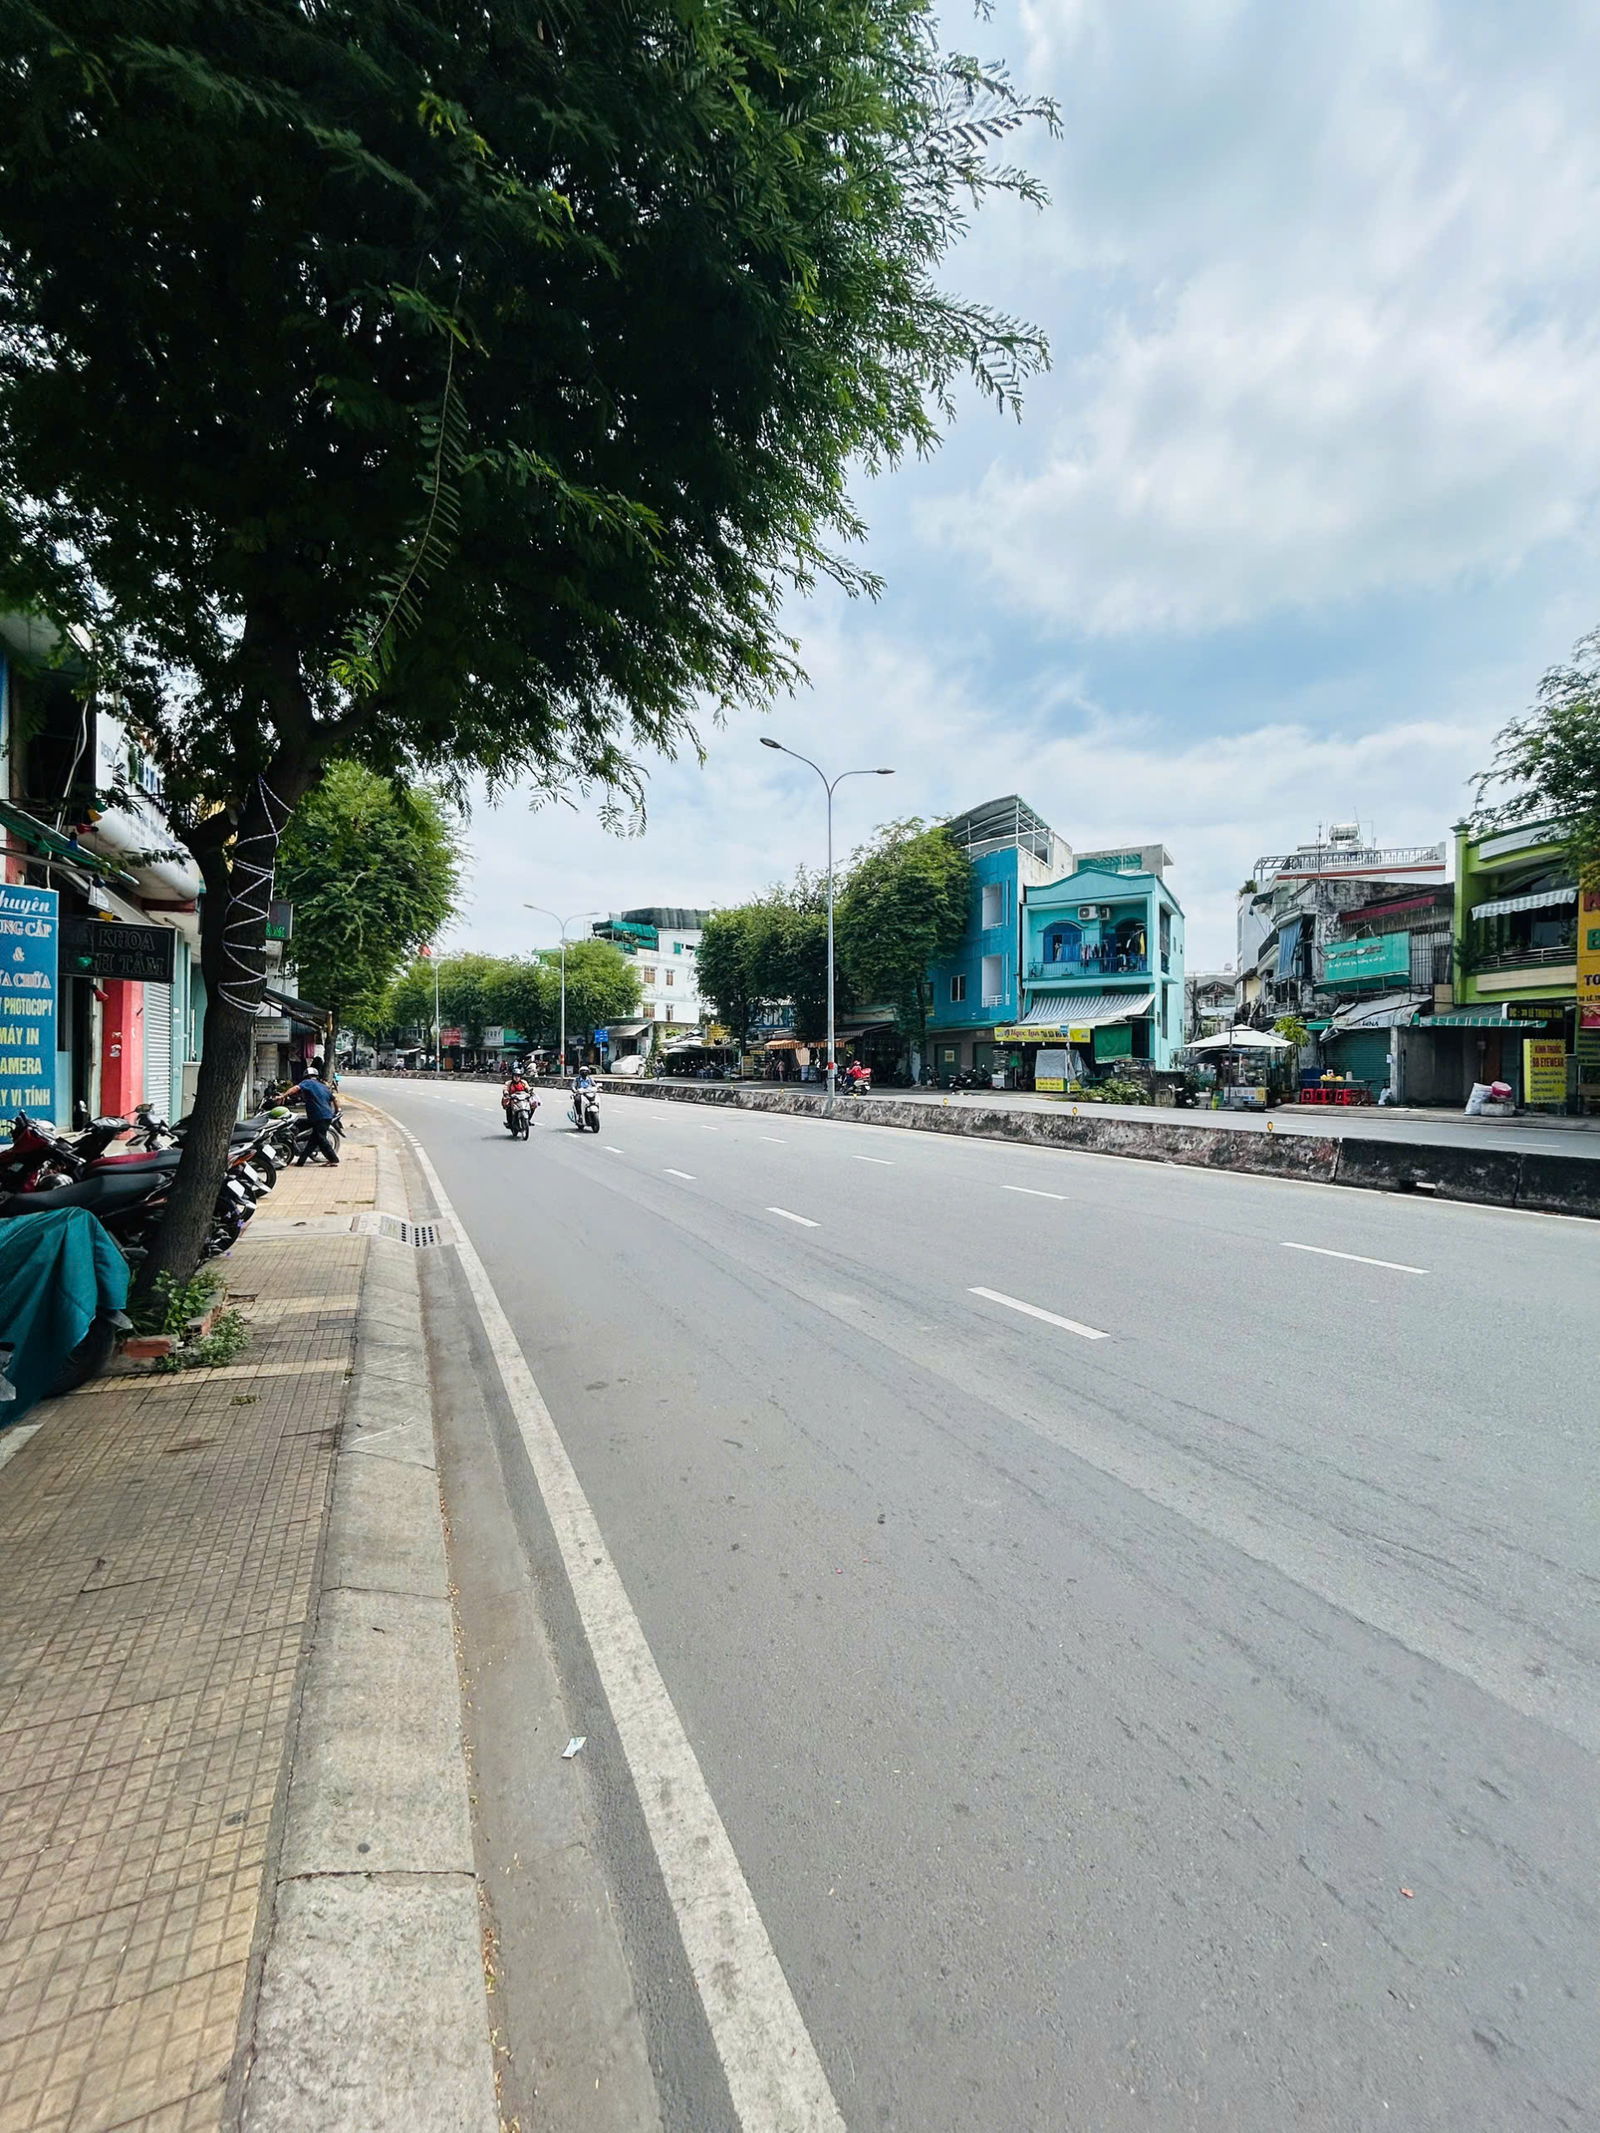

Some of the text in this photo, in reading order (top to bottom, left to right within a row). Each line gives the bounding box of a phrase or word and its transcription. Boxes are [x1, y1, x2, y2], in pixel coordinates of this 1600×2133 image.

[0, 890, 51, 914] huyên
[12, 946, 25, 962] &
[4, 998, 54, 1017] PHOTOCOPY
[26, 1027, 39, 1046] IN
[0, 1057, 42, 1075] AMERA
[10, 1088, 22, 1107] VI
[24, 1084, 51, 1107] TÍNH
